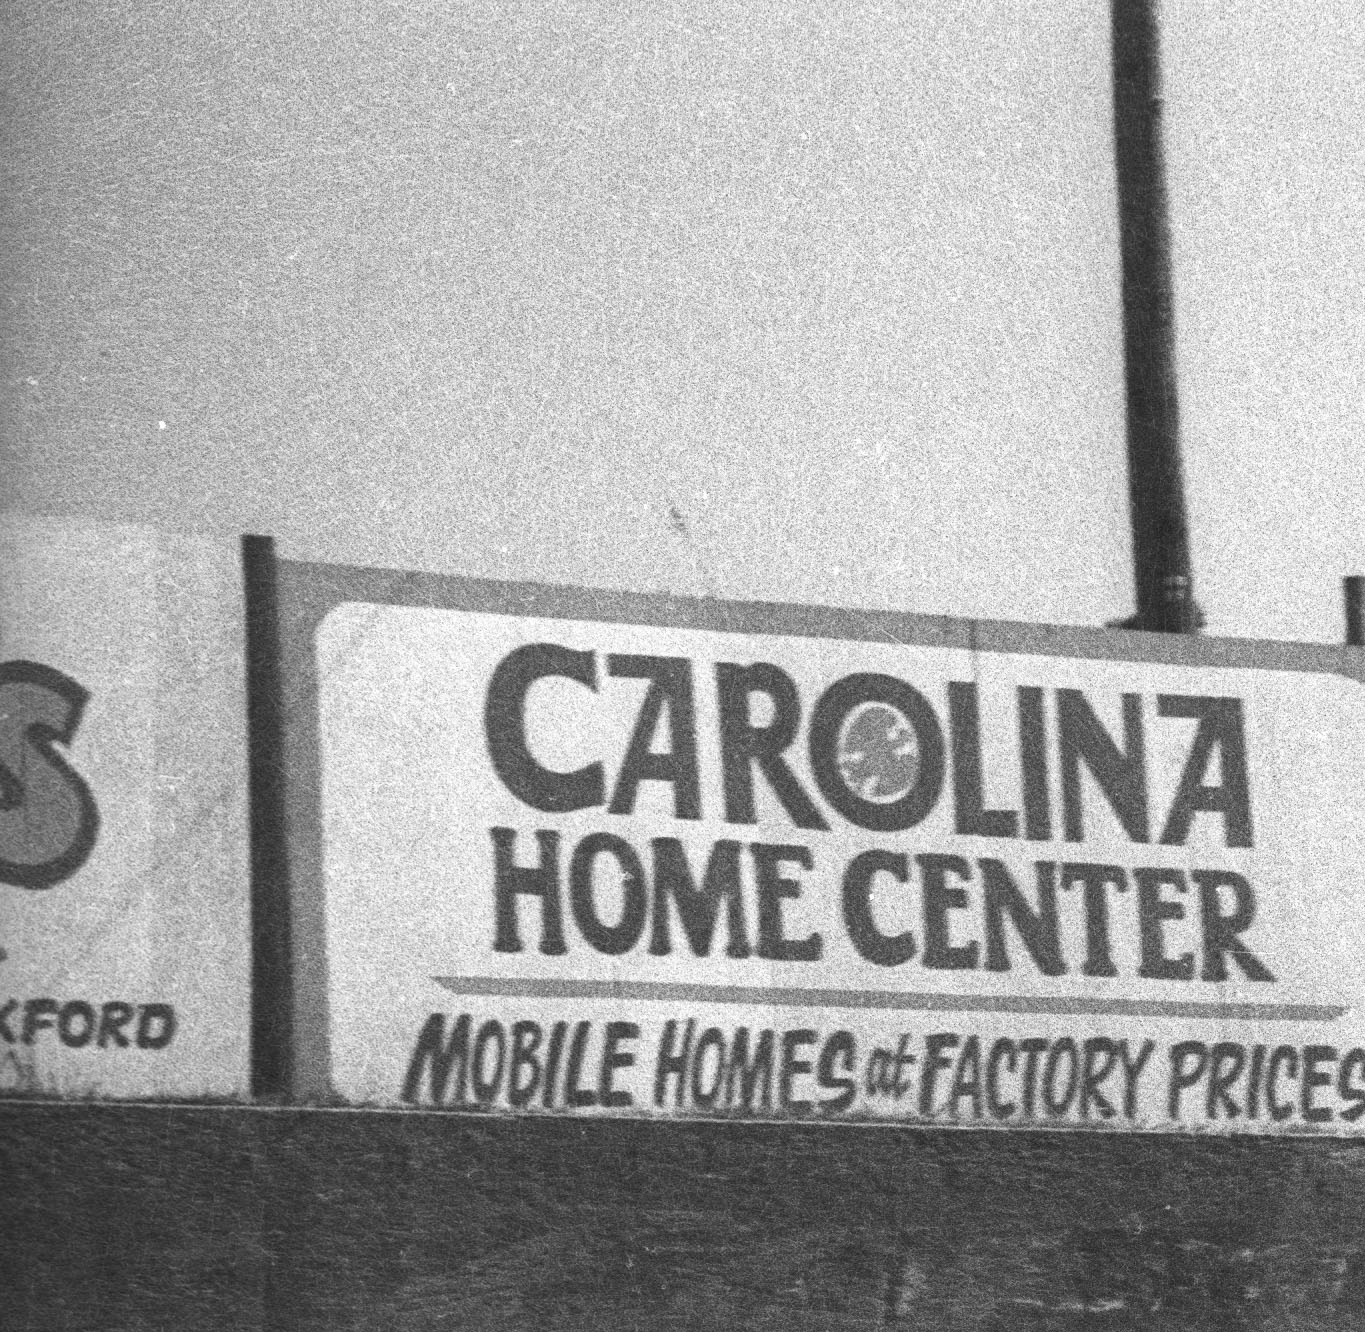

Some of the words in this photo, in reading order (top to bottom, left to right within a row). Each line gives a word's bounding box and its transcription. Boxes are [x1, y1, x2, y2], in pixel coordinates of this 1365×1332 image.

[483, 642, 1255, 849] CAROLINA
[490, 825, 824, 963] HOME
[841, 848, 1279, 984] CENTER
[400, 1011, 641, 1107] MOBILE
[653, 1016, 859, 1117] HOMES
[917, 1032, 1155, 1122] FACTORY
